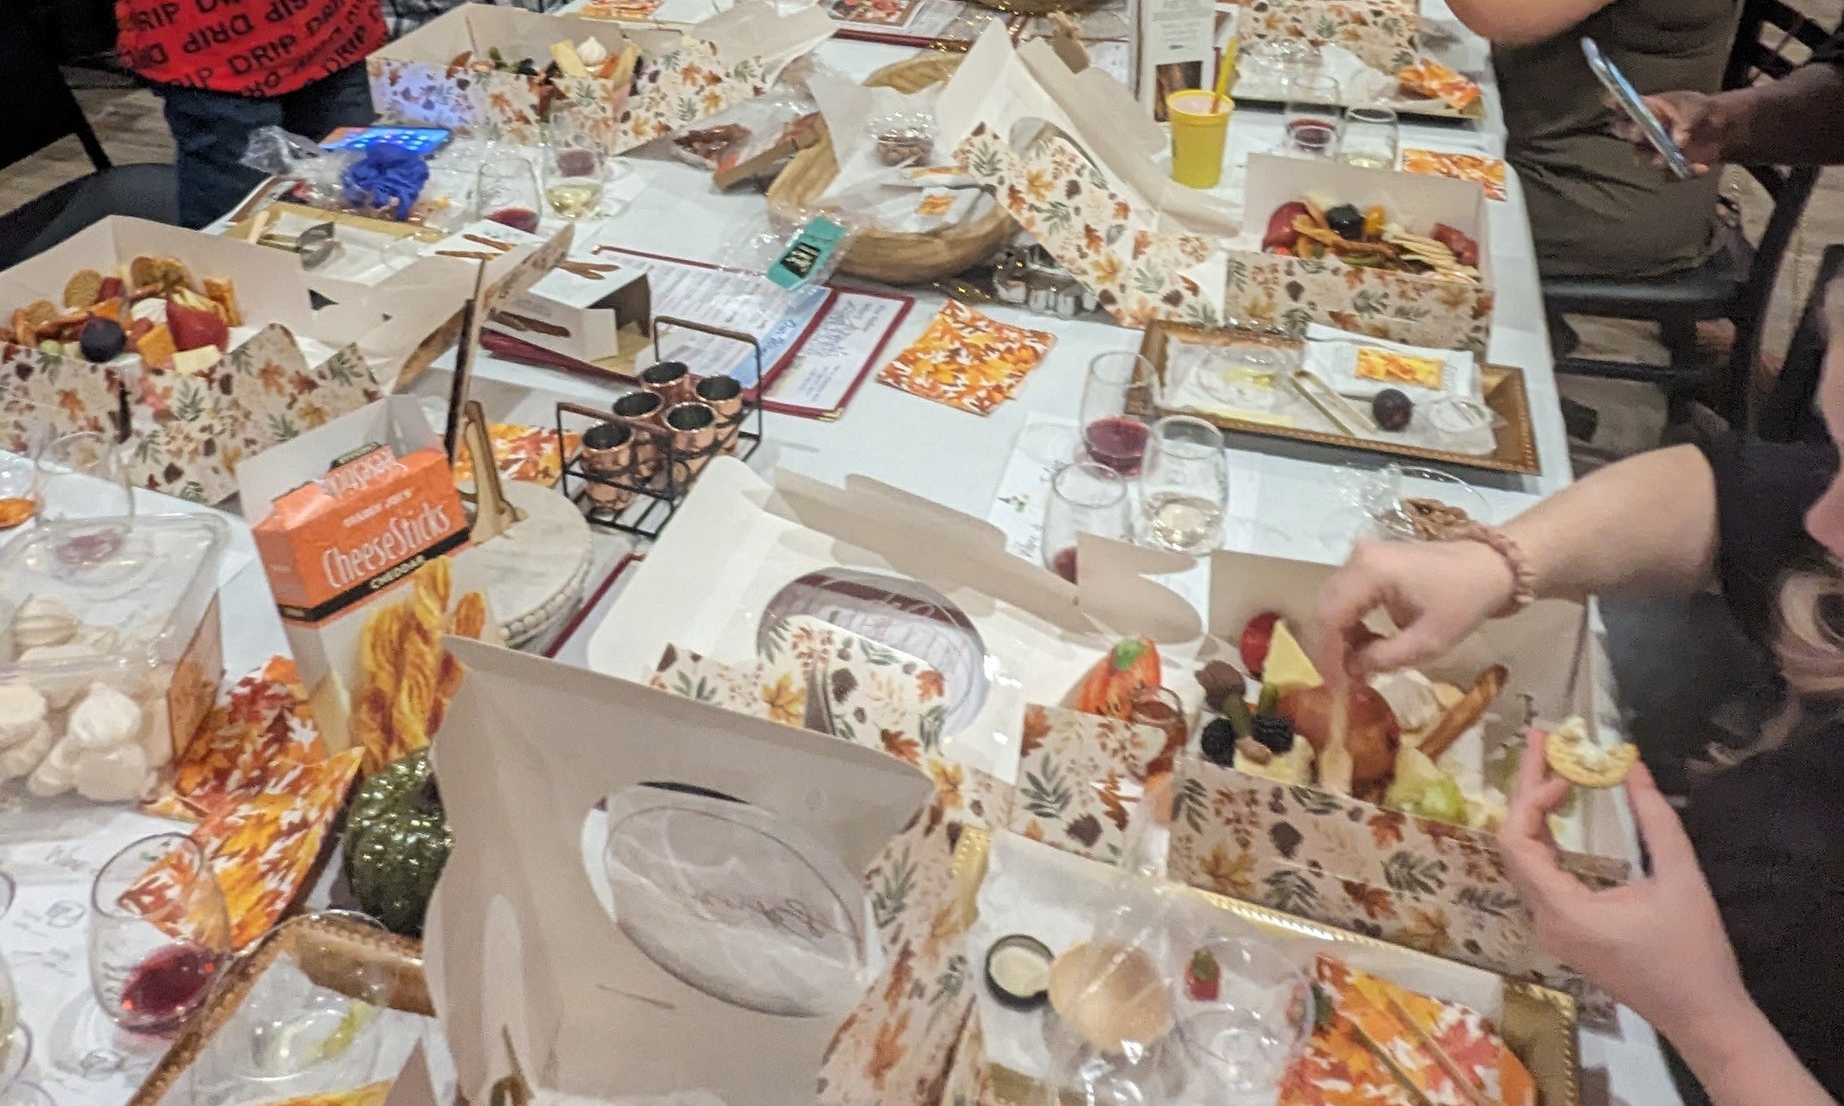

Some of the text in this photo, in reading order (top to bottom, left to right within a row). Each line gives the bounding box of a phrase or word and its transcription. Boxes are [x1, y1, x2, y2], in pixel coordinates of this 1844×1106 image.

[182, 13, 254, 54] DRIP
[228, 34, 296, 75] DRIP
[369, 554, 426, 589] CHEDDAR
